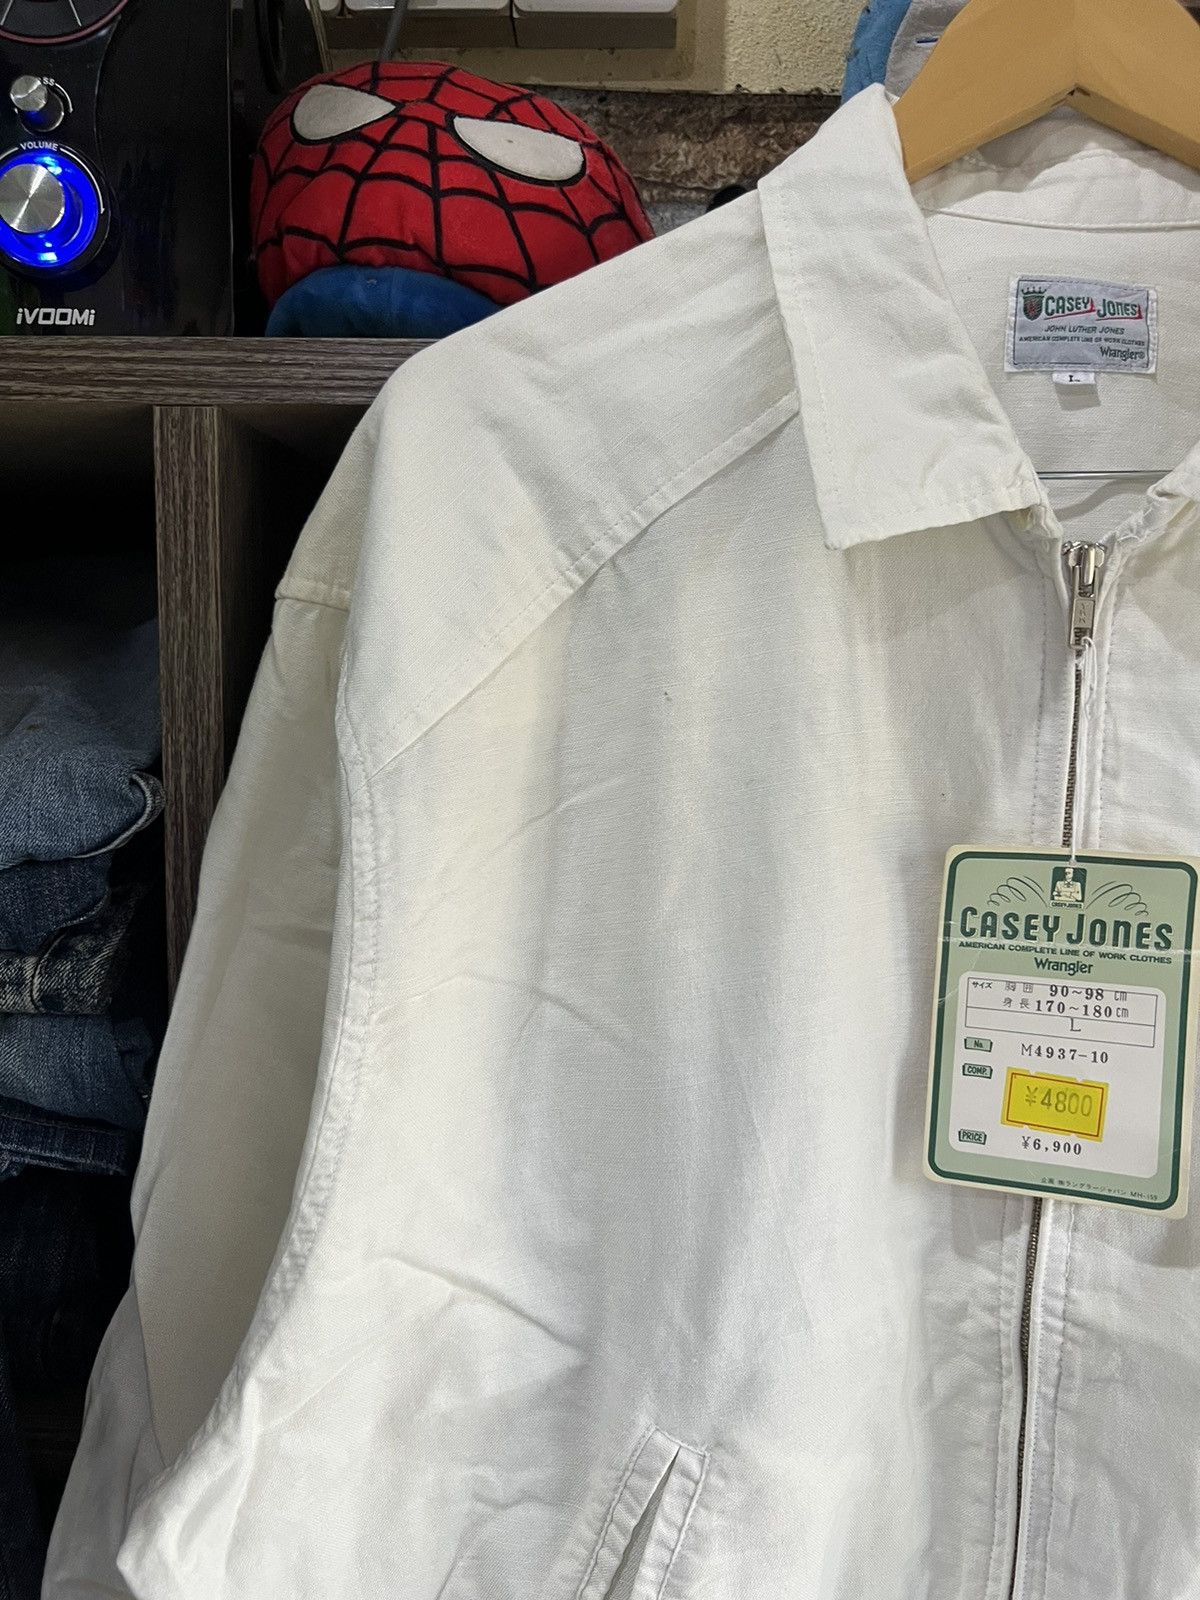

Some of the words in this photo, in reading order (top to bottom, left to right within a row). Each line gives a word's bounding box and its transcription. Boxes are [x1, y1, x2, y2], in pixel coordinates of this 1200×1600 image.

[20, 141, 59, 152] VOLUME
[1044, 295, 1090, 317] CASEY
[1097, 298, 1138, 318] JONES
[16, 307, 96, 326] iVOOMi
[1044, 325, 1067, 333] JOHN
[1068, 325, 1098, 334] LUTHER
[1099, 326, 1125, 335] JONES
[959, 906, 1061, 943] CASEY
[1065, 913, 1174, 951] JONES
[959, 941, 1005, 950] AMERICAN
[1008, 944, 1057, 955] COMPLETE
[1060, 948, 1080, 957] LINE
[1083, 950, 1096, 958] OF
[1099, 951, 1127, 961] WORK
[1130, 954, 1172, 965] CLOTHES
[1034, 957, 1094, 976] Wrangler
[972, 981, 993, 989] サイズ
[1070, 1017, 1082, 1032] L
[1021, 1043, 1109, 1064] M4937-10
[1025, 1085, 1093, 1117] ¥4800
[961, 1131, 984, 1142] PRICE
[1021, 1135, 1083, 1156] ¥6,900
